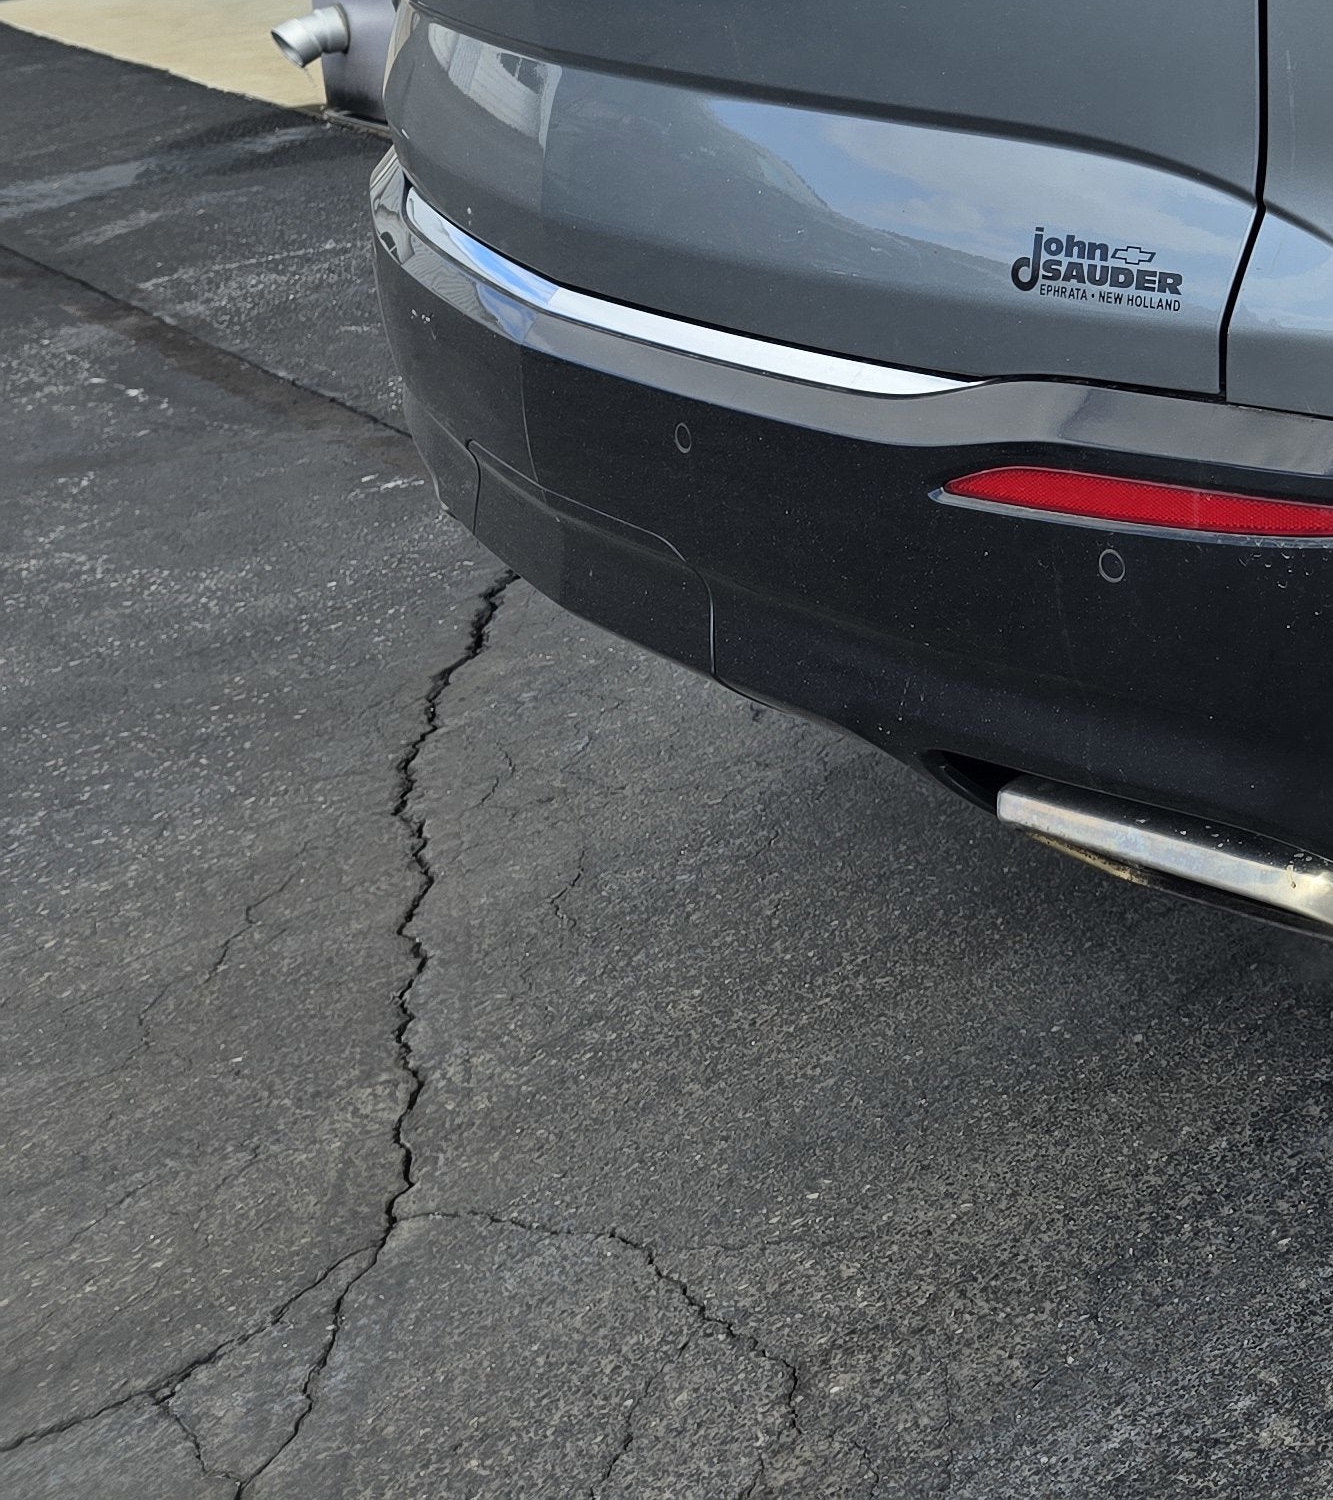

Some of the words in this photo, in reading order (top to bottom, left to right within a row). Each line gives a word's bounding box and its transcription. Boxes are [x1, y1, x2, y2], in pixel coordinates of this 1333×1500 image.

[1011, 226, 1109, 291] john
[1041, 259, 1183, 295] SAUDER
[1039, 284, 1088, 301] EPHRATA
[1098, 291, 1124, 305] NEW
[1126, 293, 1182, 312] HOLLAND
